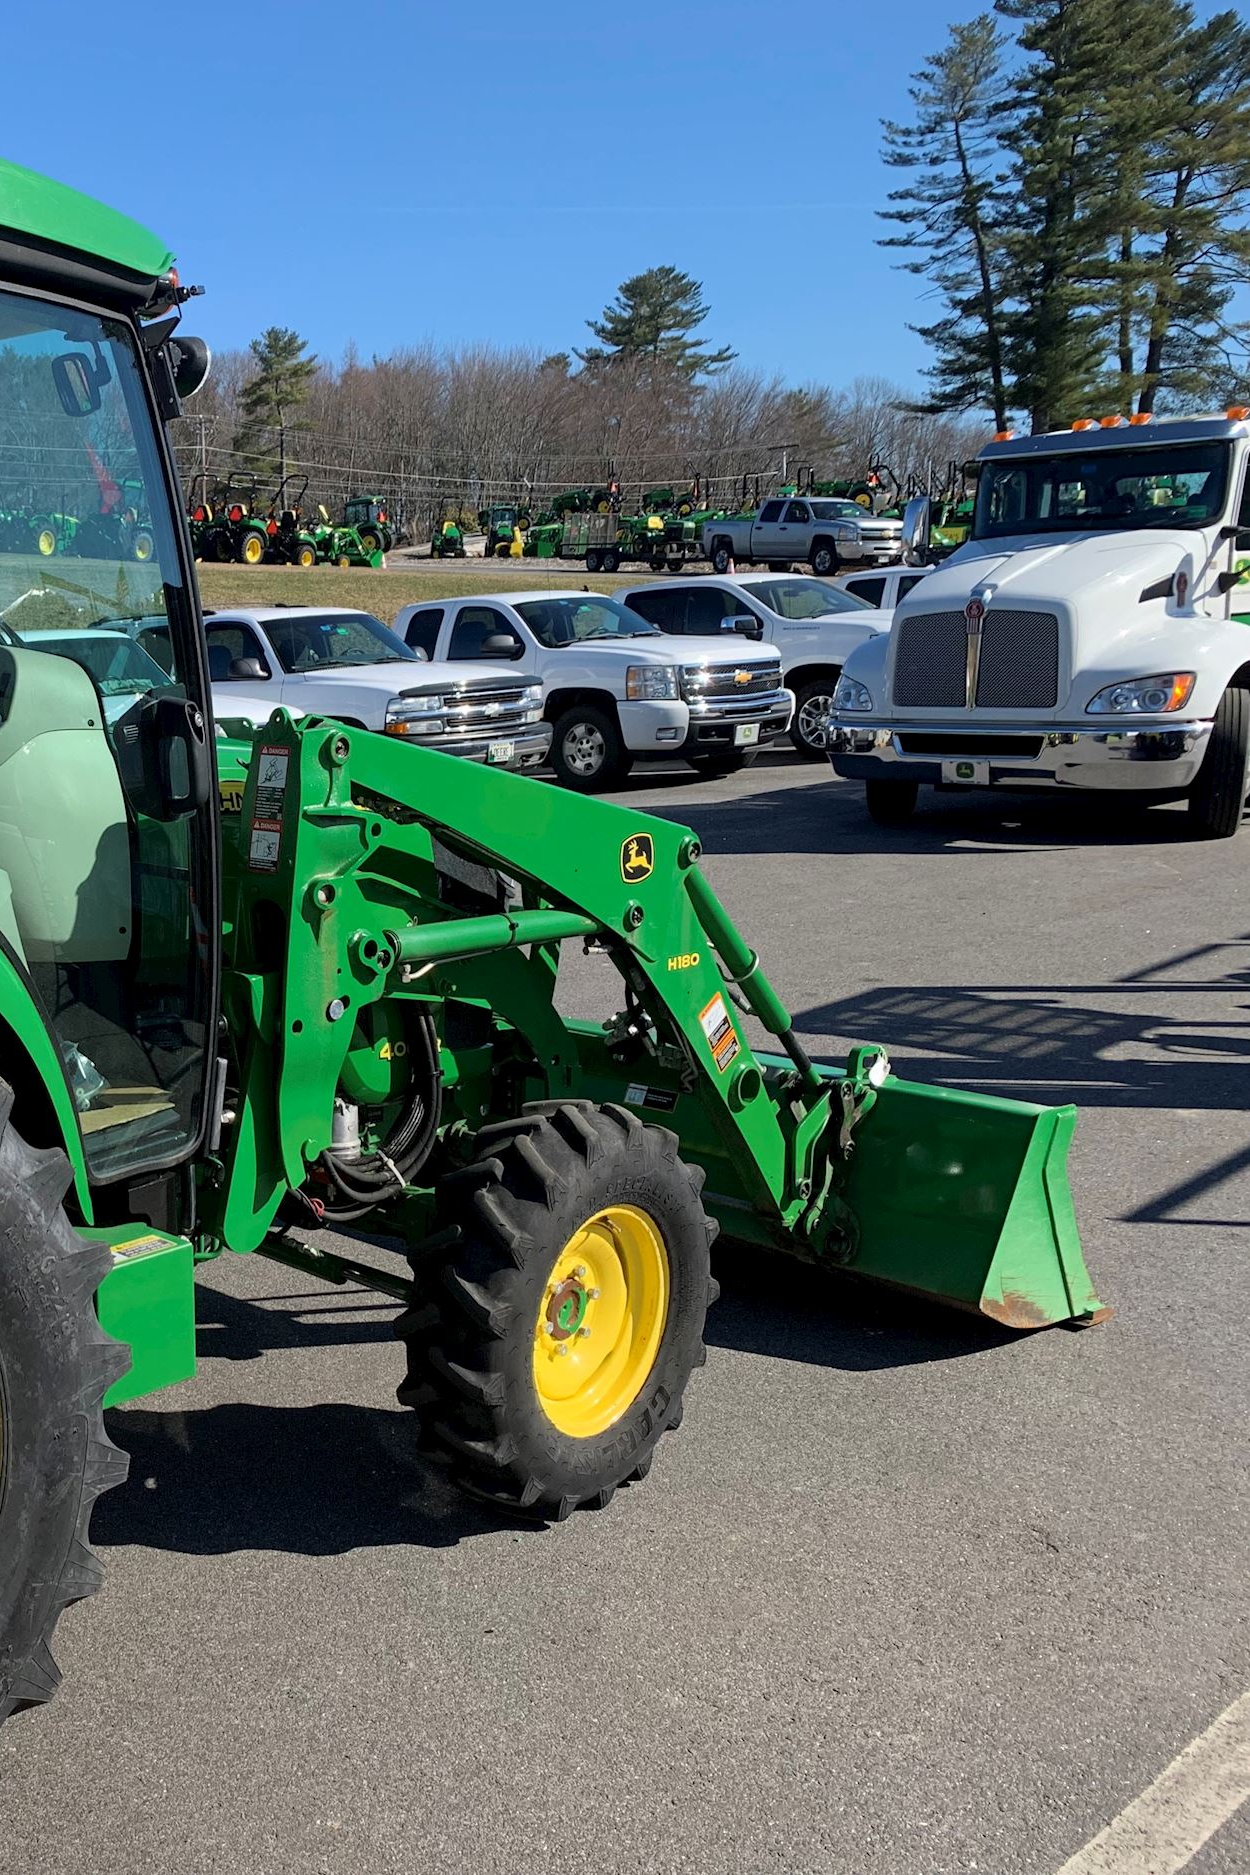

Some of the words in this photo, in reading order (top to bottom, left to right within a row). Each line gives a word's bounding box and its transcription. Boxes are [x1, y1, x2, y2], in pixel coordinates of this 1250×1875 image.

[268, 747, 289, 755] DANGER
[259, 822, 281, 831] DANGER
[667, 952, 700, 971] H180
